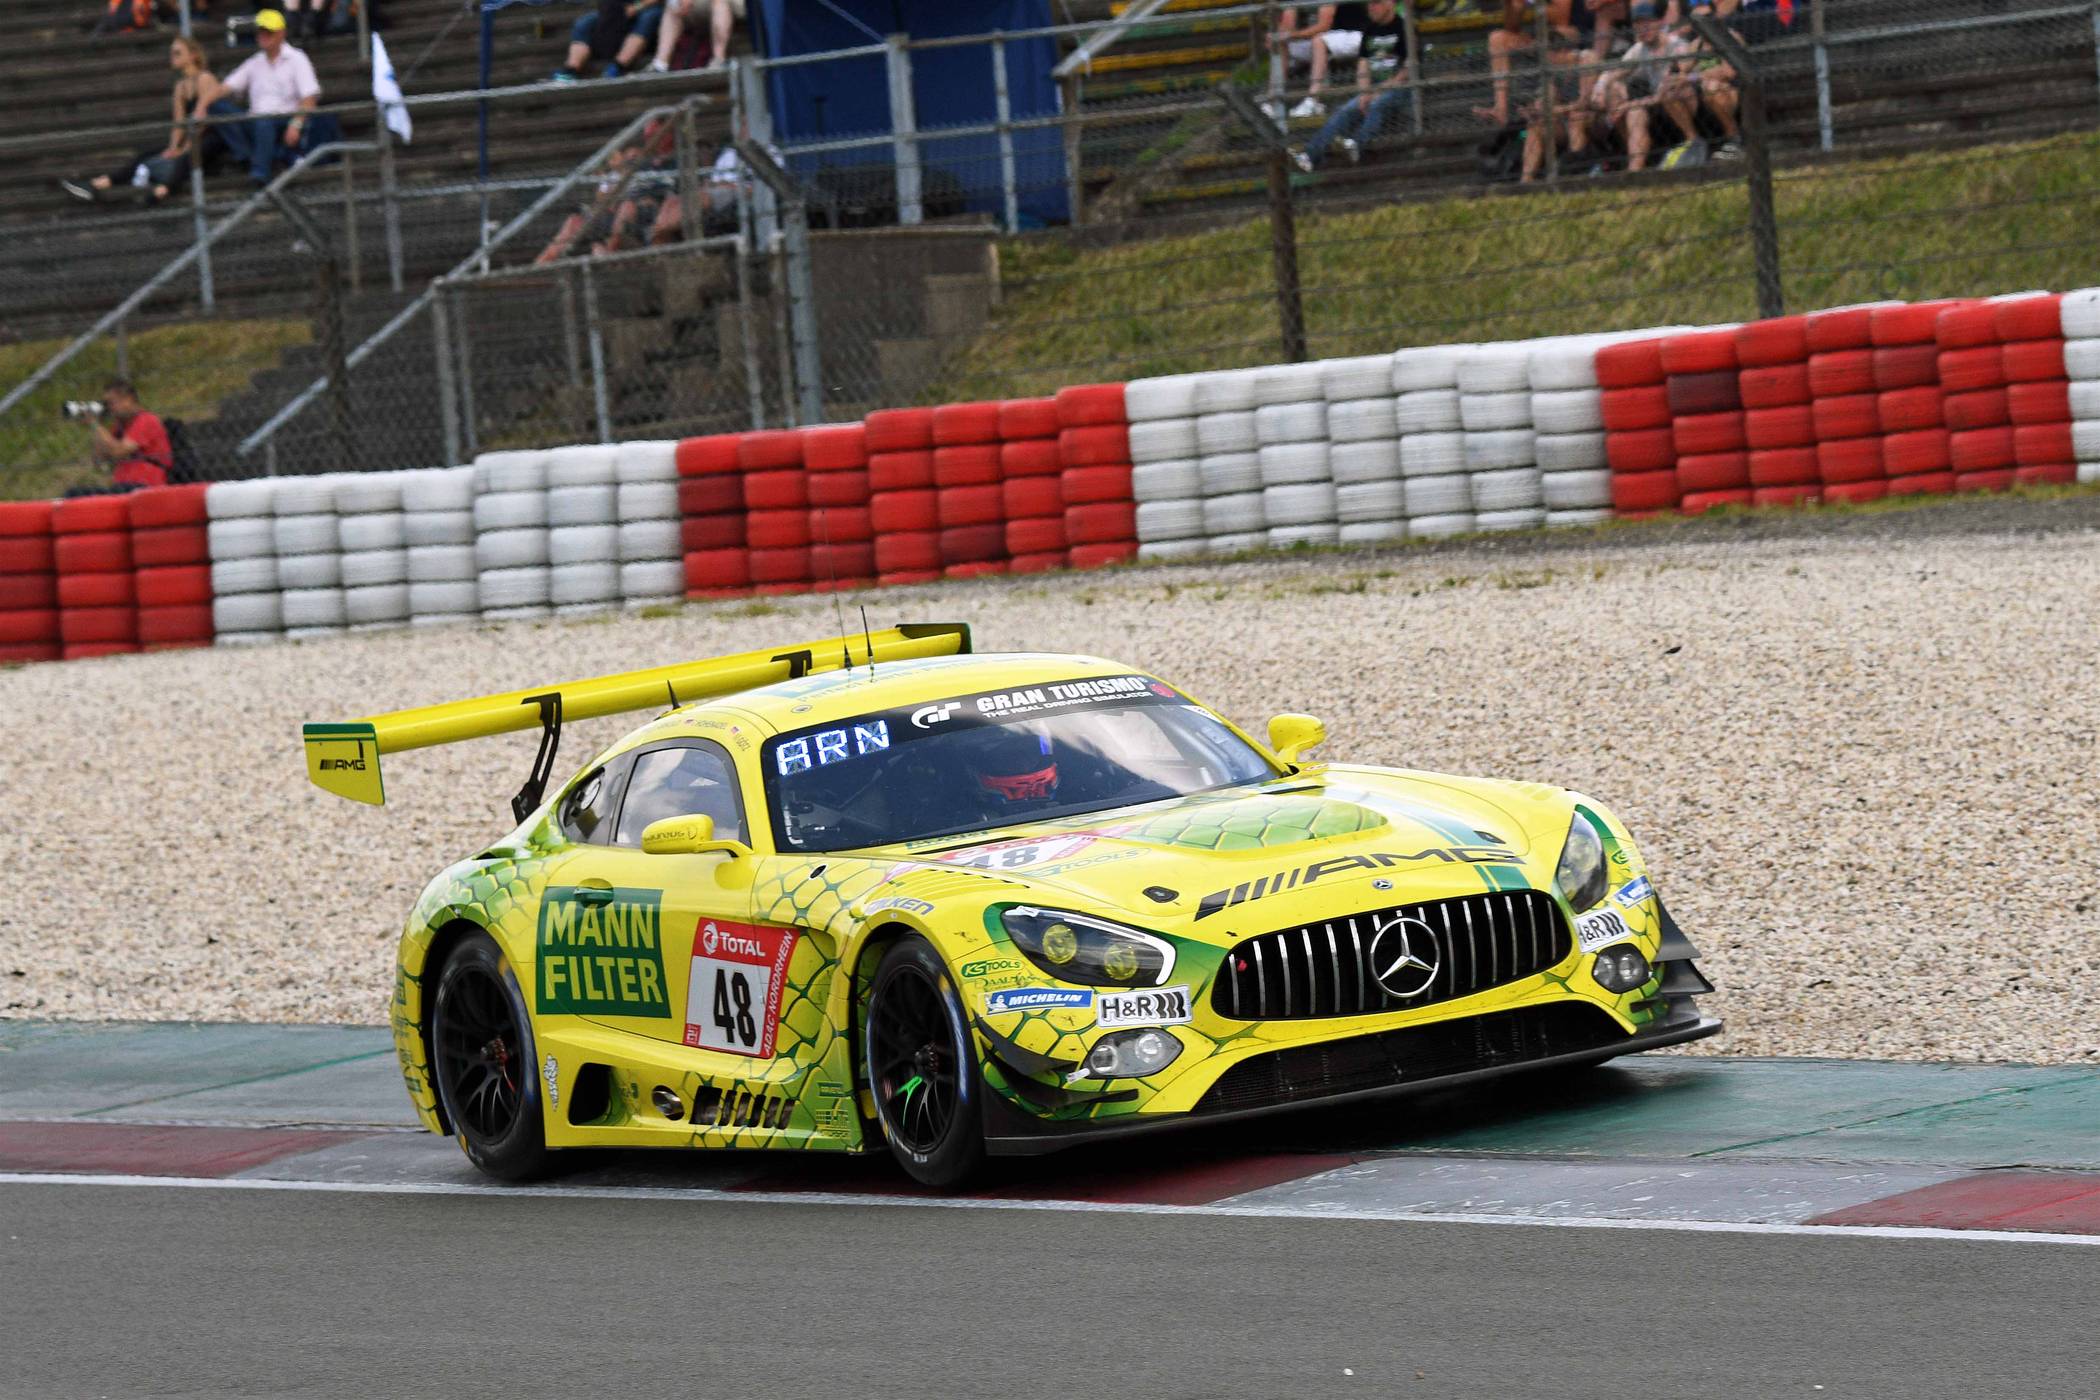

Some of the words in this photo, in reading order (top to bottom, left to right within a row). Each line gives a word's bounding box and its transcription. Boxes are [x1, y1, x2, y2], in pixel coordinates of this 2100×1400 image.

[976, 688, 1048, 713] GRAN
[1048, 677, 1147, 700] TURISMO
[1010, 705, 1044, 715] REAL
[1044, 697, 1092, 709] DRIVING
[335, 759, 366, 771] AMG
[776, 720, 890, 776] ARN
[1302, 848, 1527, 885] AMG
[544, 900, 655, 949] MANN
[719, 931, 766, 957] TOTAL
[544, 955, 664, 1004] FILTER
[769, 930, 794, 1014] NORDRHEIN
[986, 961, 1021, 971] TOOLS
[713, 968, 757, 1047] 48
[1008, 993, 1083, 1006] MICHELIN
[1102, 995, 1153, 1019] H&R
[763, 1014, 776, 1057] ADAC
